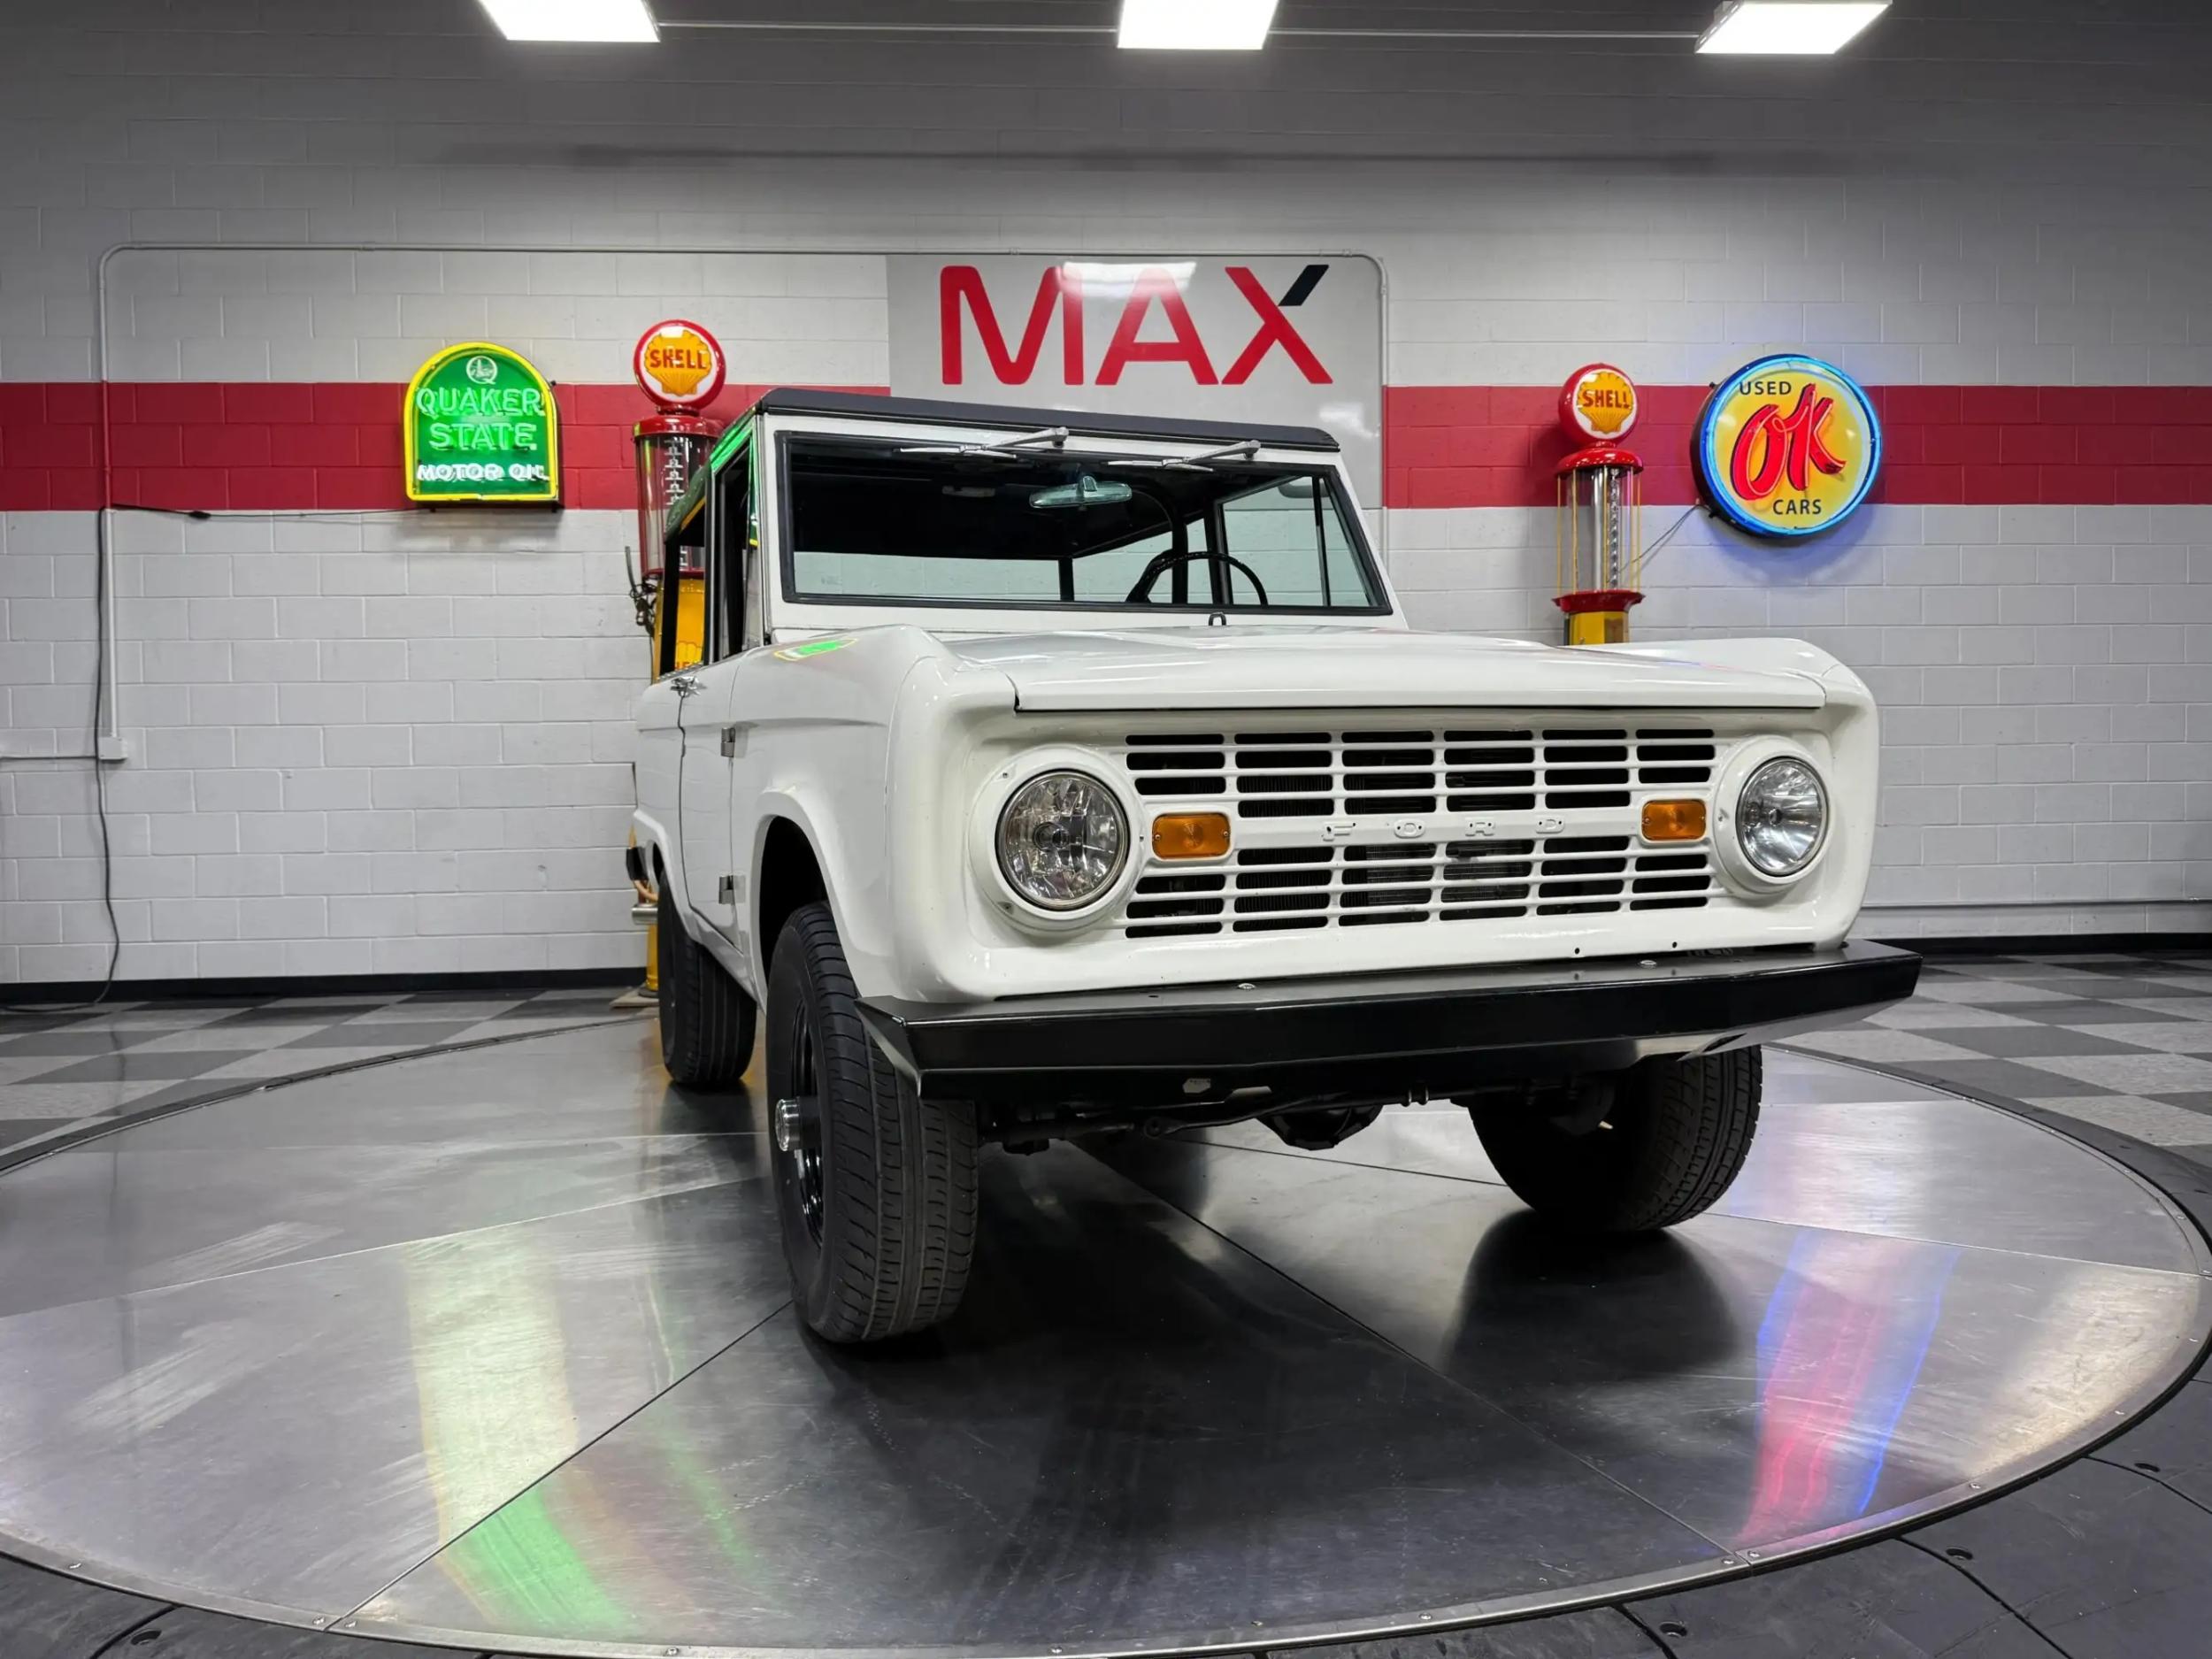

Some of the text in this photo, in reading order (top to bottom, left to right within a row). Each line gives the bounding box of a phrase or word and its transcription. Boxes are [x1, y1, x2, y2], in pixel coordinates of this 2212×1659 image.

[941, 265, 1333, 385] MAX
[649, 349, 707, 369] SHELL
[1740, 381, 1792, 396] USED
[416, 387, 546, 419] QUAKER
[1582, 390, 1630, 409] SHELL
[429, 422, 537, 450] STATE
[417, 464, 550, 482] MOTOR OIL
[1772, 499, 1822, 515] CARS
[1323, 815, 1564, 841] FORD
